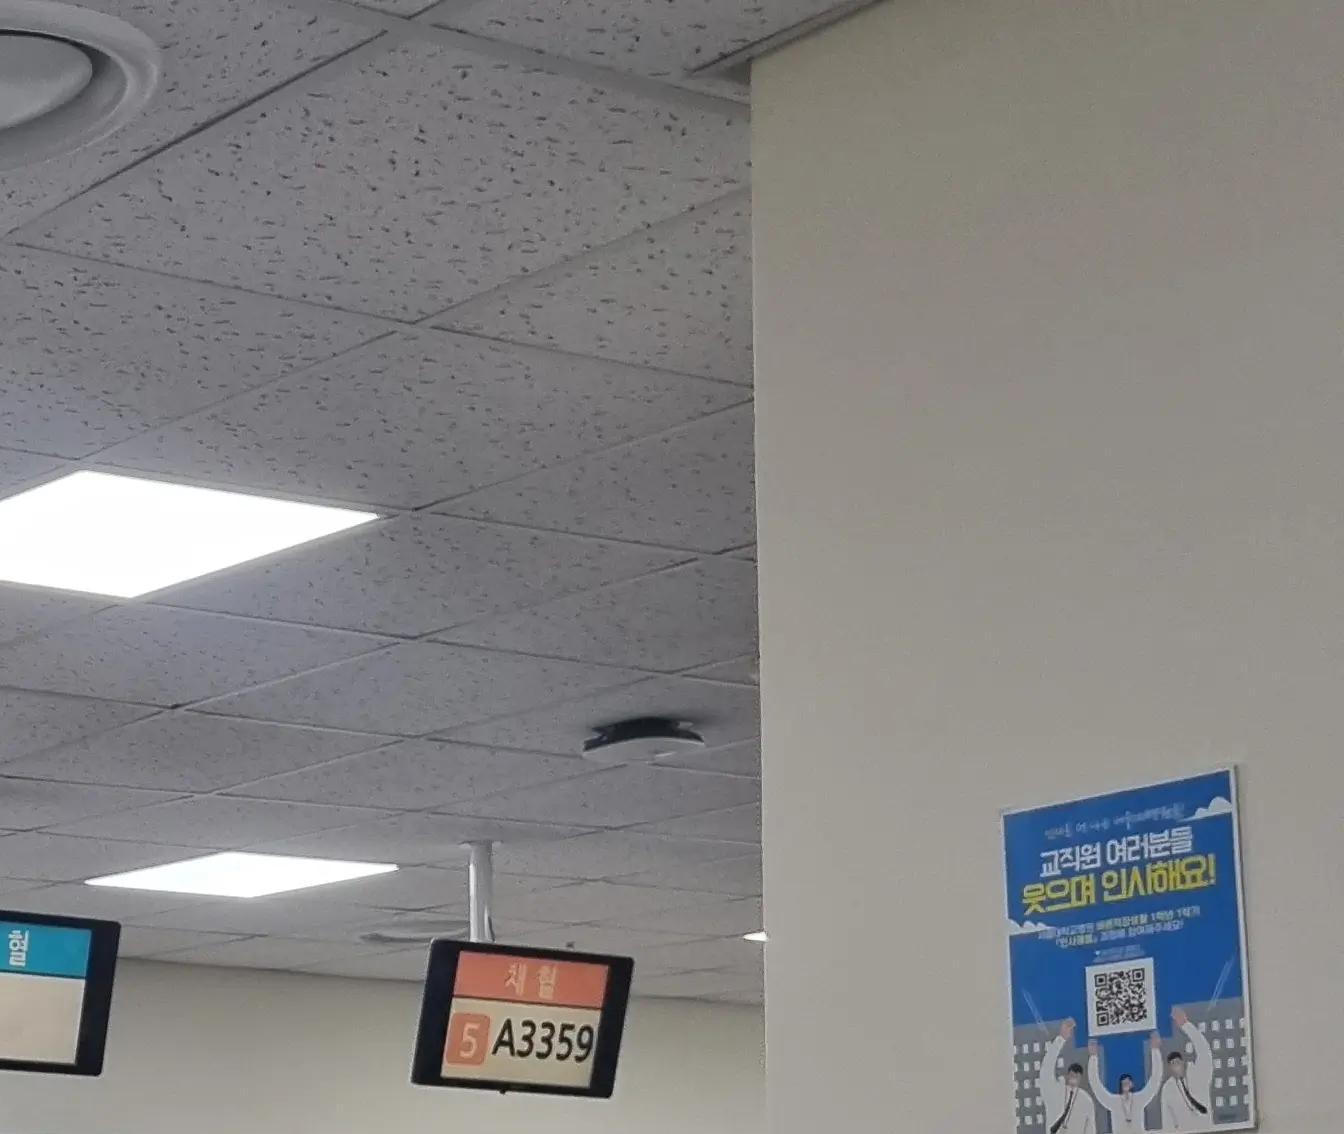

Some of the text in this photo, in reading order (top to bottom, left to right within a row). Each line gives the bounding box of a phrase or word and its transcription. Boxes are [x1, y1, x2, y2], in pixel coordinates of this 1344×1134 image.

[1040, 826, 1193, 877] 교직원 여러분들
[1022, 854, 1216, 915] 웃으며 인사해요!
[458, 1024, 594, 1065] 5 A3359
